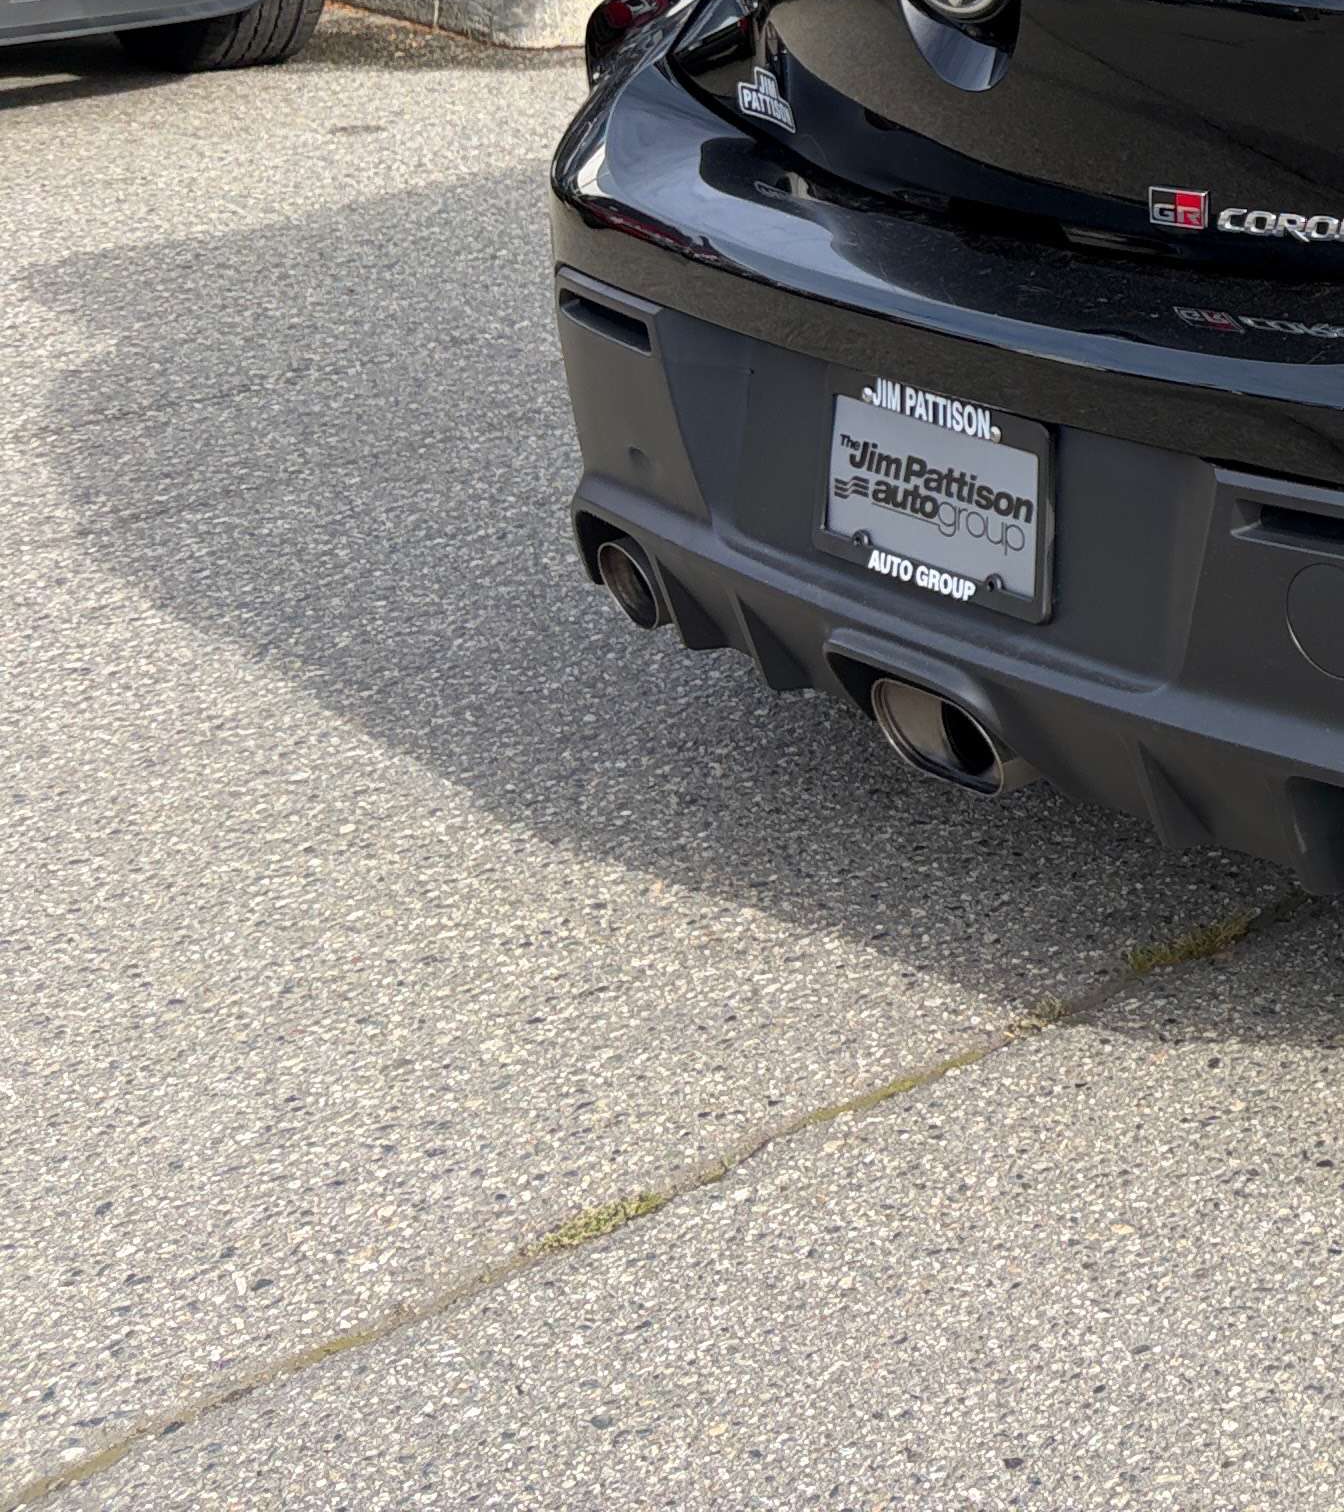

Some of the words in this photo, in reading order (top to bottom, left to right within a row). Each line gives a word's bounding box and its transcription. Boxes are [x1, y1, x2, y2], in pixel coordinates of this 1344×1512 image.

[760, 74, 778, 99] JIM
[742, 88, 794, 129] PATTISON
[1152, 203, 1201, 227] GR
[872, 377, 901, 413] JIM
[905, 386, 992, 440] PATTISON
[840, 433, 861, 451] The
[867, 549, 914, 582] AUTO
[915, 565, 977, 602] GROUP
